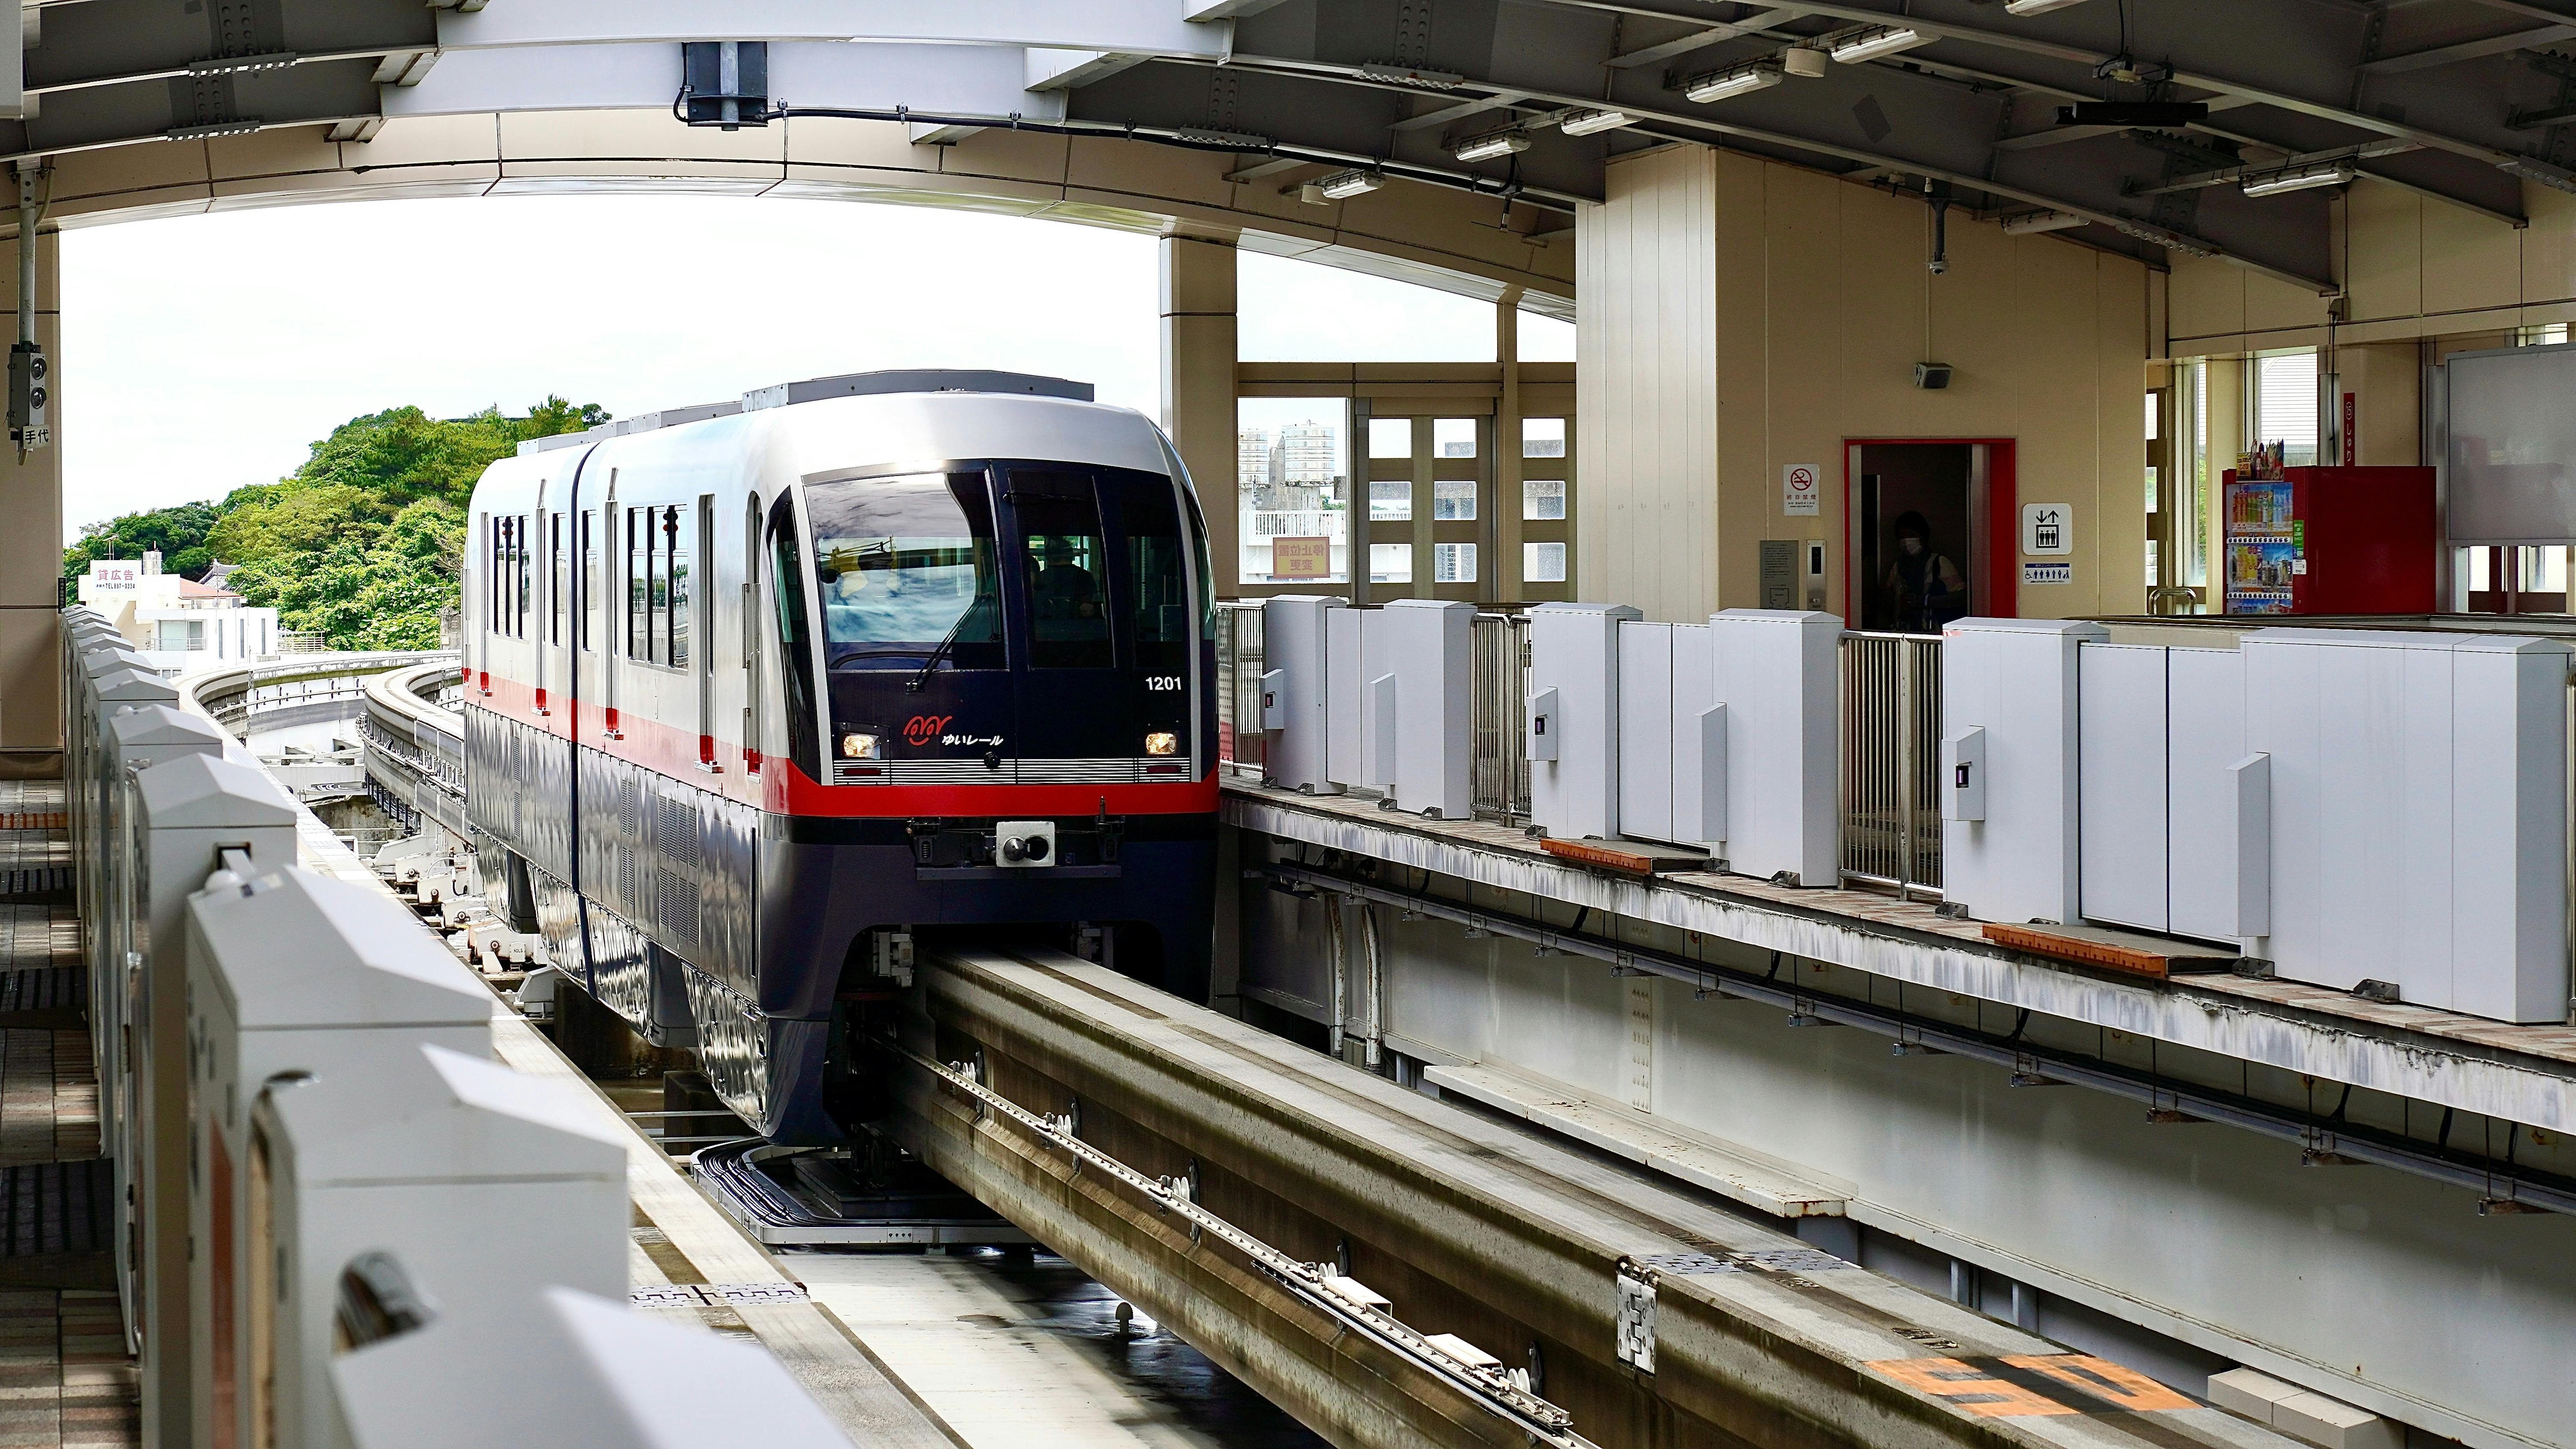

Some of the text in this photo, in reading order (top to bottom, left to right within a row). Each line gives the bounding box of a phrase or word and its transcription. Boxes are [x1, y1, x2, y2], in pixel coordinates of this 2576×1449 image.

[25, 429, 49, 444] 手代
[98, 569, 134, 580] 貸広告
[1145, 676, 1181, 690] 1201
[942, 734, 1004, 746] ゆいレール
